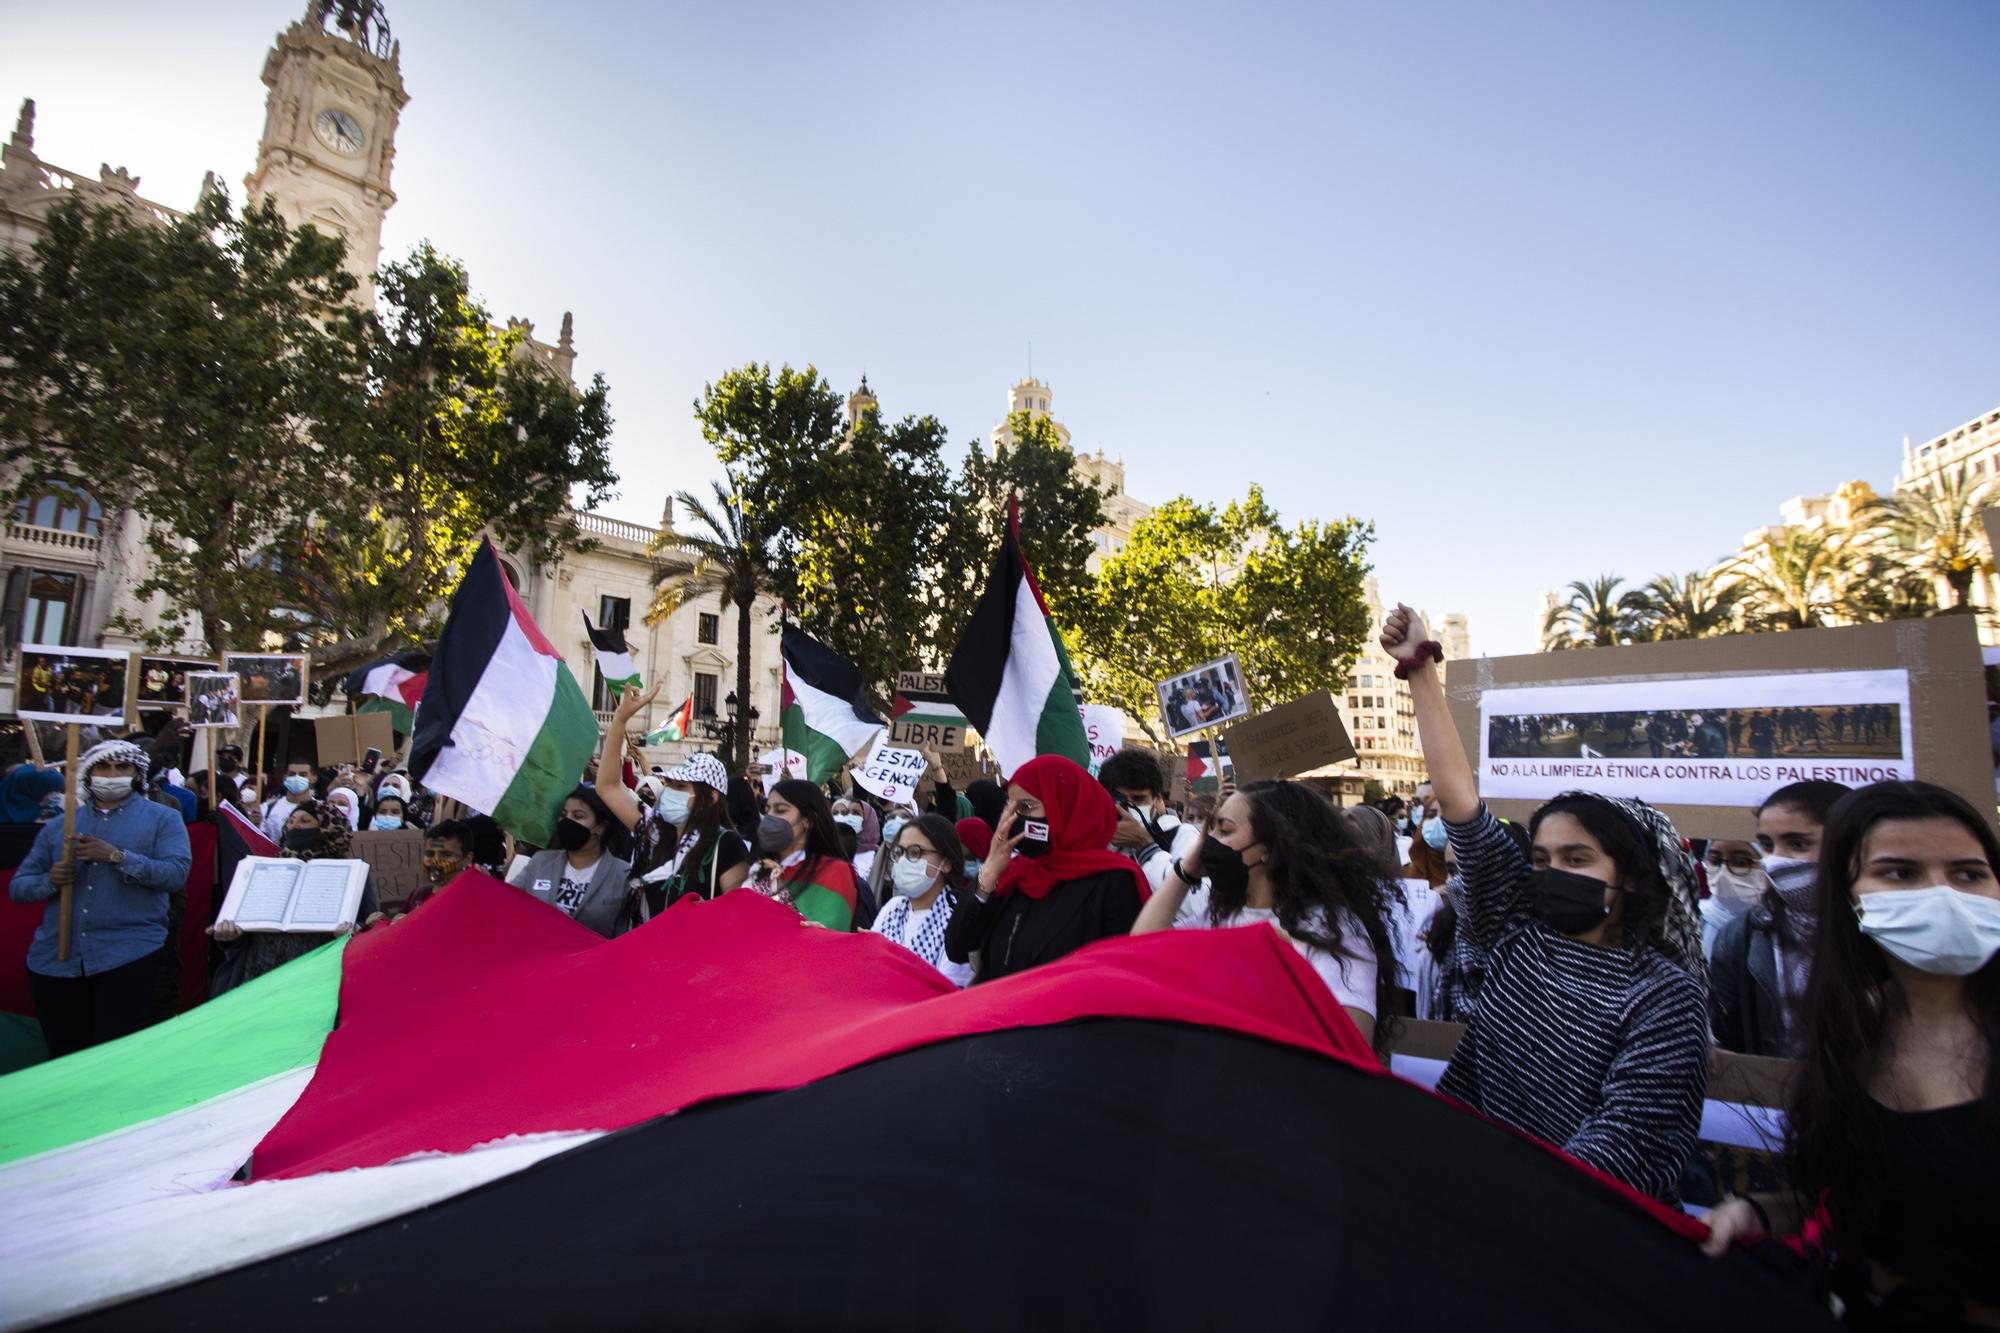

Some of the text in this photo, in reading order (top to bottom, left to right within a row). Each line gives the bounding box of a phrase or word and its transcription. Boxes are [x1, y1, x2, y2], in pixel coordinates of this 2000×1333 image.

[900, 674, 948, 692] PALEST
[876, 750, 926, 769] ESTAD
[1491, 762, 1900, 783] NO A LA LIMPIEZA ÉTNICA CONTRA LOS PALESTINOS
